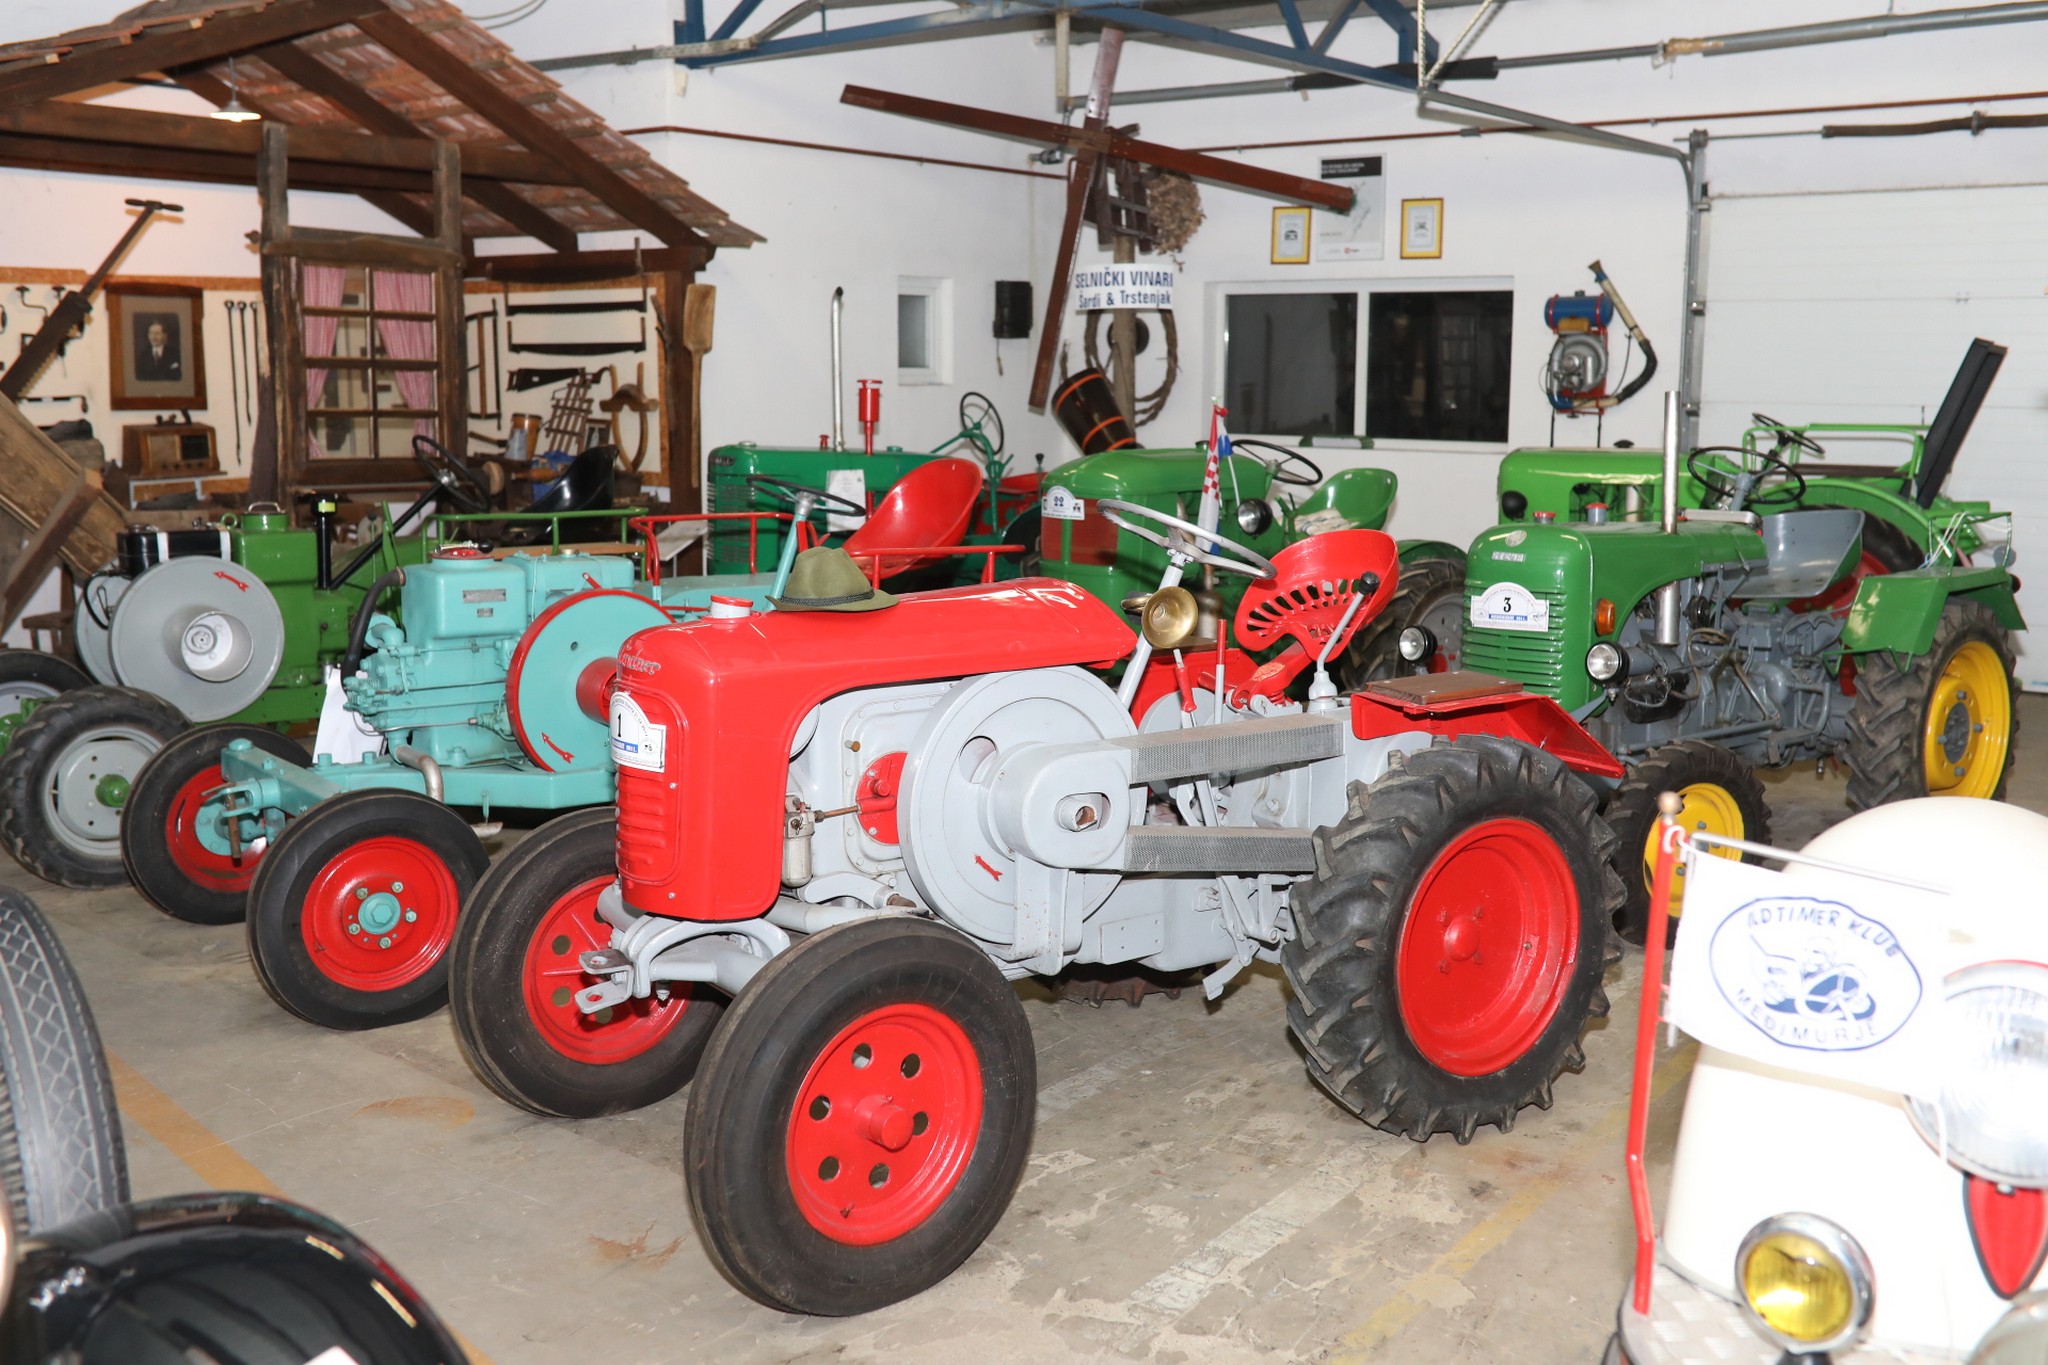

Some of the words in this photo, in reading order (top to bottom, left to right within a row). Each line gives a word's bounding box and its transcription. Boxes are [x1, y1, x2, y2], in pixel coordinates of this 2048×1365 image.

[1076, 267, 1124, 288] SELNIČKI
[1131, 271, 1173, 287] VINARI
[1106, 292, 1114, 306] &
[1120, 290, 1171, 307] Trstenjak
[1503, 596, 1512, 613] 3
[617, 713, 622, 737] 1
